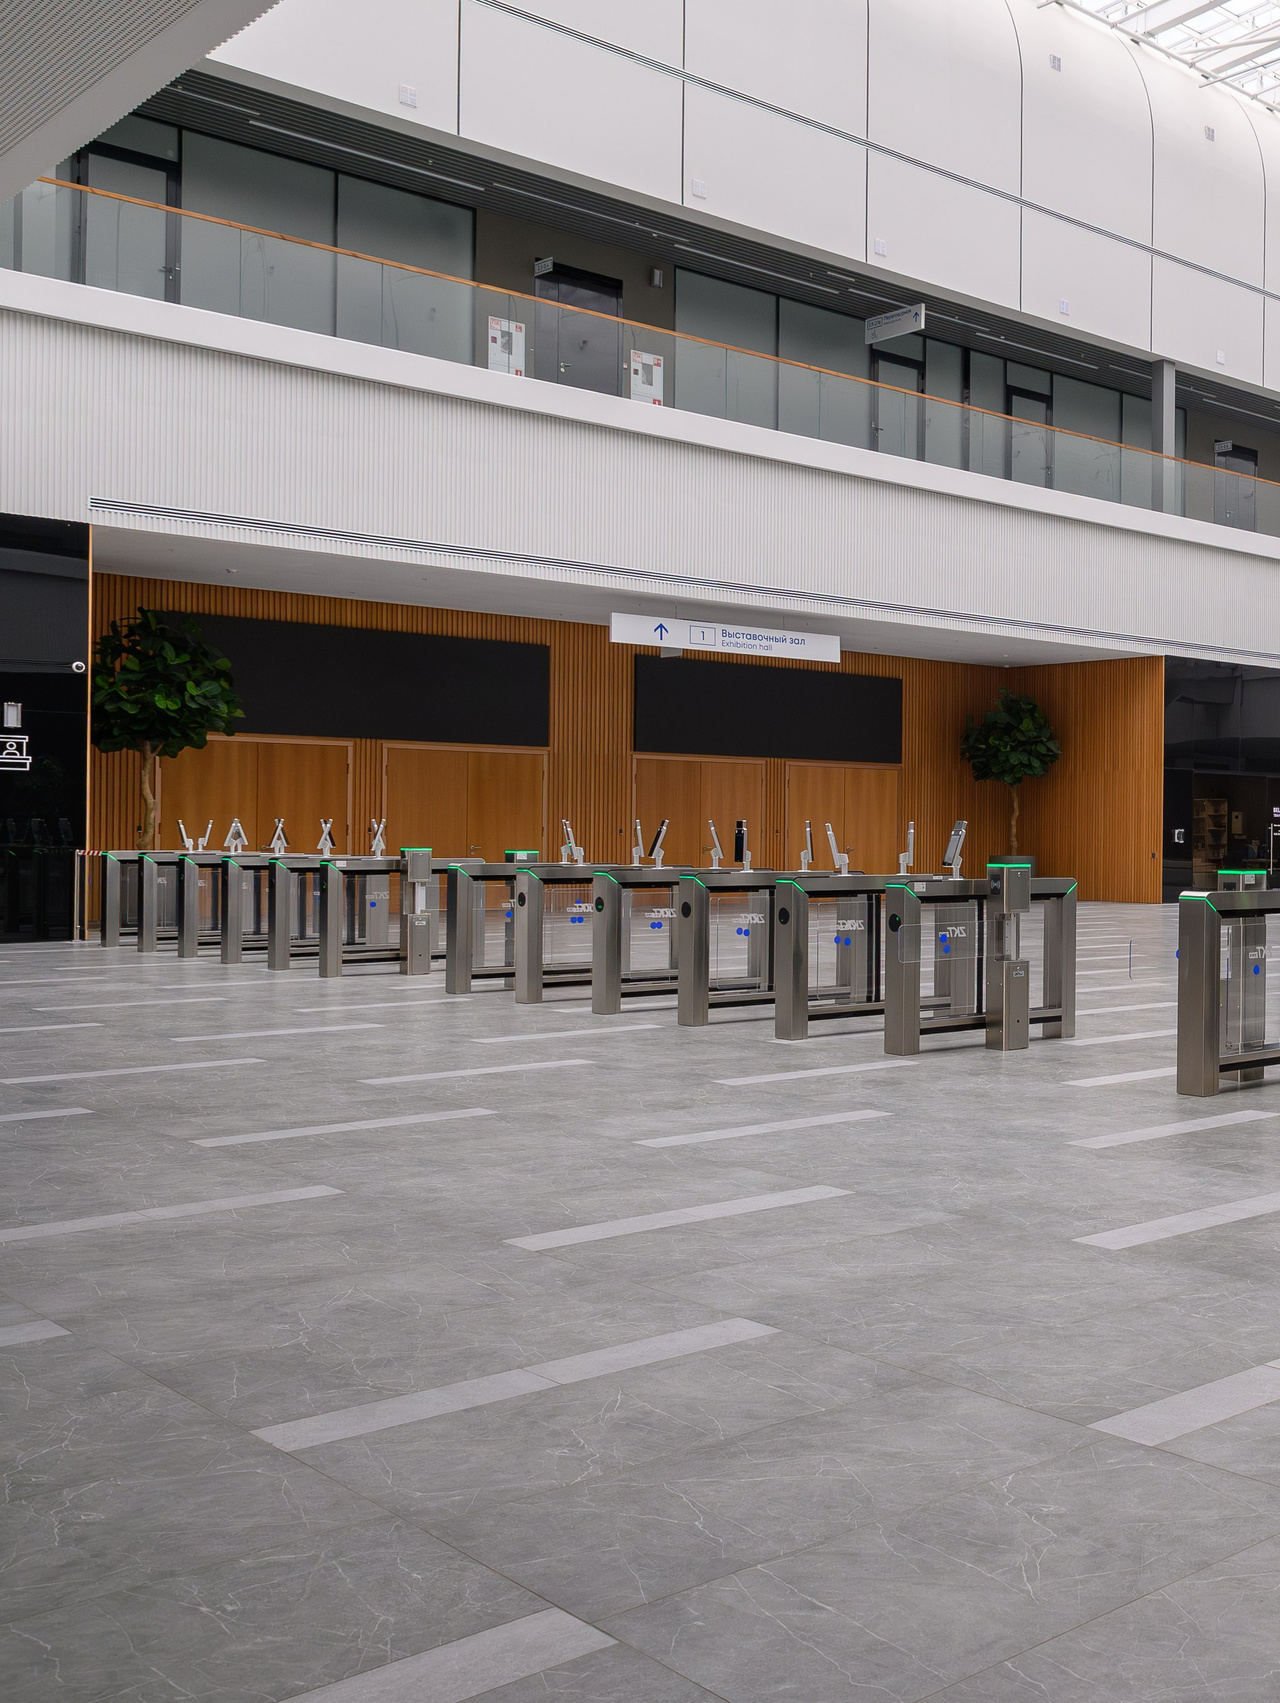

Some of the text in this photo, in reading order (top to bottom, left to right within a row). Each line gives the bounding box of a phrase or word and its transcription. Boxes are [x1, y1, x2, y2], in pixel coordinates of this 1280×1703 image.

[701, 630, 705, 641] 1
[721, 629, 806, 646] Выставочный зал
[721, 639, 773, 651] Exhibition hall
